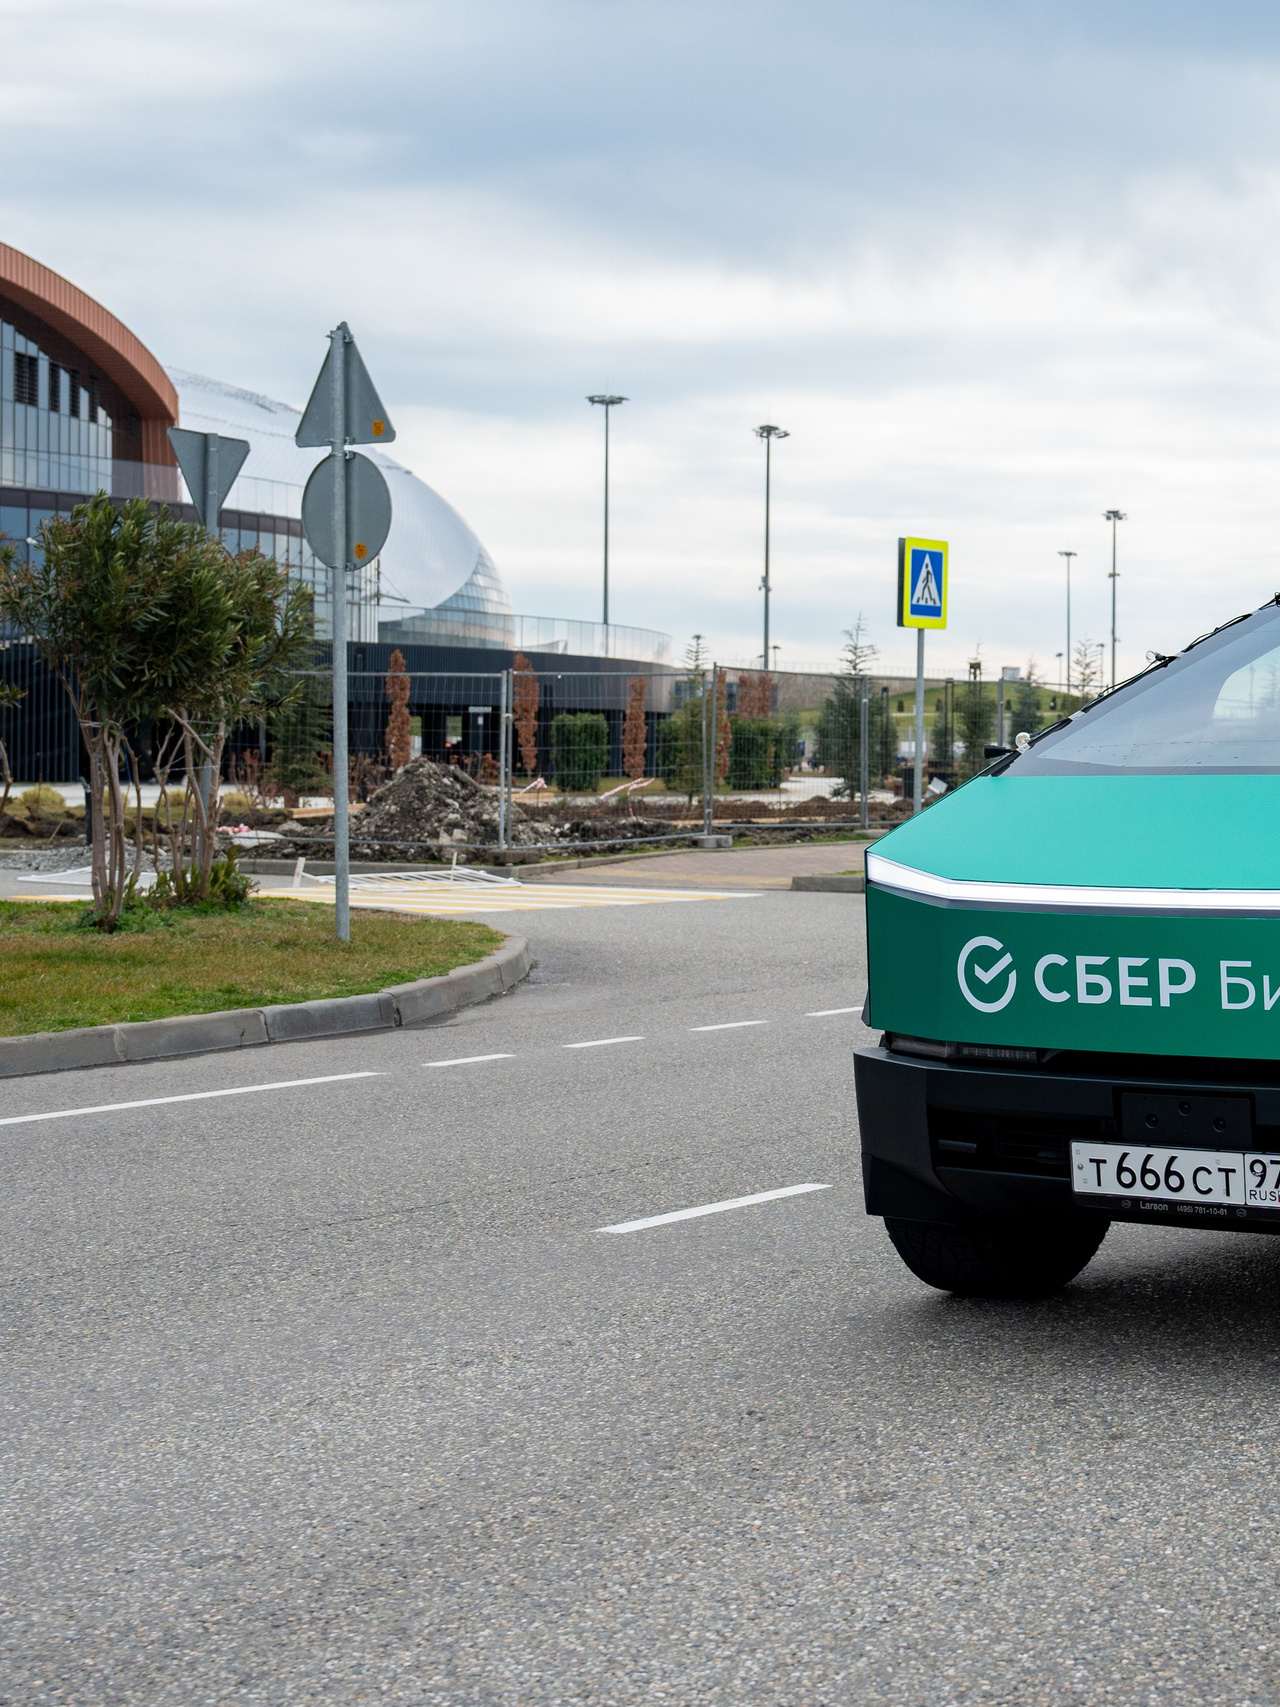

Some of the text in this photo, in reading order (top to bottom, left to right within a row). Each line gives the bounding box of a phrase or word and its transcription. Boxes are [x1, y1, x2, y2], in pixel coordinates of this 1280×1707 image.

[1034, 953, 1197, 1007] СБЕР
[1089, 1151, 1237, 1197] Т666СТ
[1140, 1200, 1169, 1211] Larson
[1177, 1205, 1194, 1214] (495)
[1249, 1189, 1277, 1202] RUS
